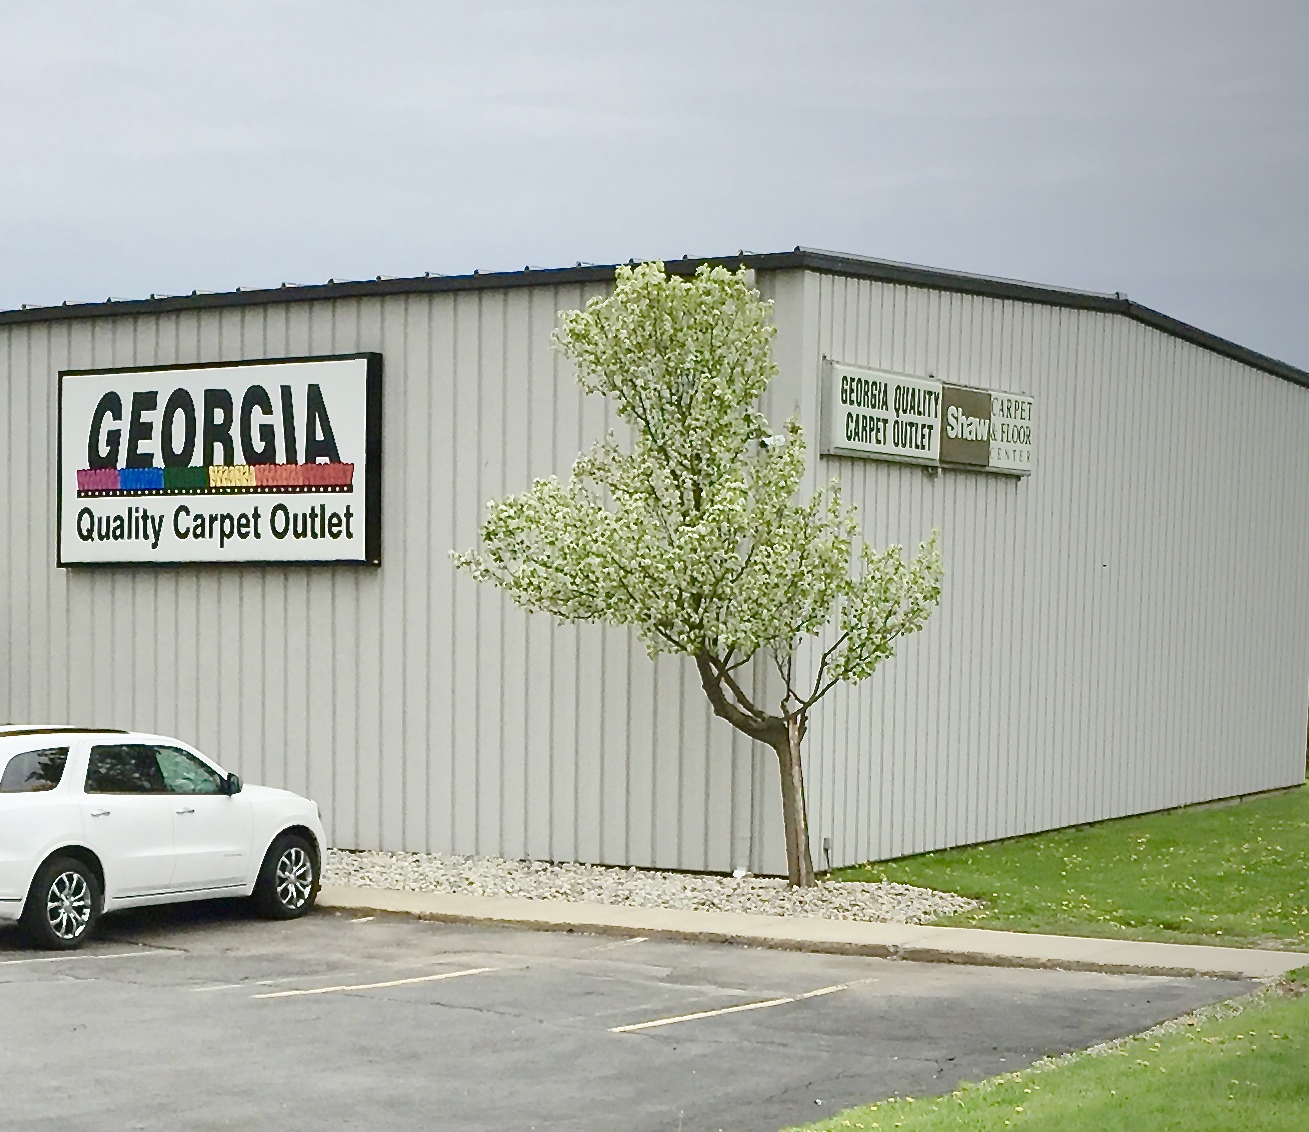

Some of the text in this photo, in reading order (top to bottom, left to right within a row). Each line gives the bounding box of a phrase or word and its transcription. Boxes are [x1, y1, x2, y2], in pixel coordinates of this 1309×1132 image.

[840, 375, 940, 419] GEORGIA QUALITY
[992, 397, 1033, 422] CARPET
[87, 383, 341, 469] GEORGIA
[845, 411, 934, 452] CARPET OUTLET
[946, 405, 990, 442] Shaw
[990, 422, 1032, 446] & FLOOR
[989, 447, 1031, 463] CENTER
[76, 503, 355, 550] Quality Carpet Outlet
